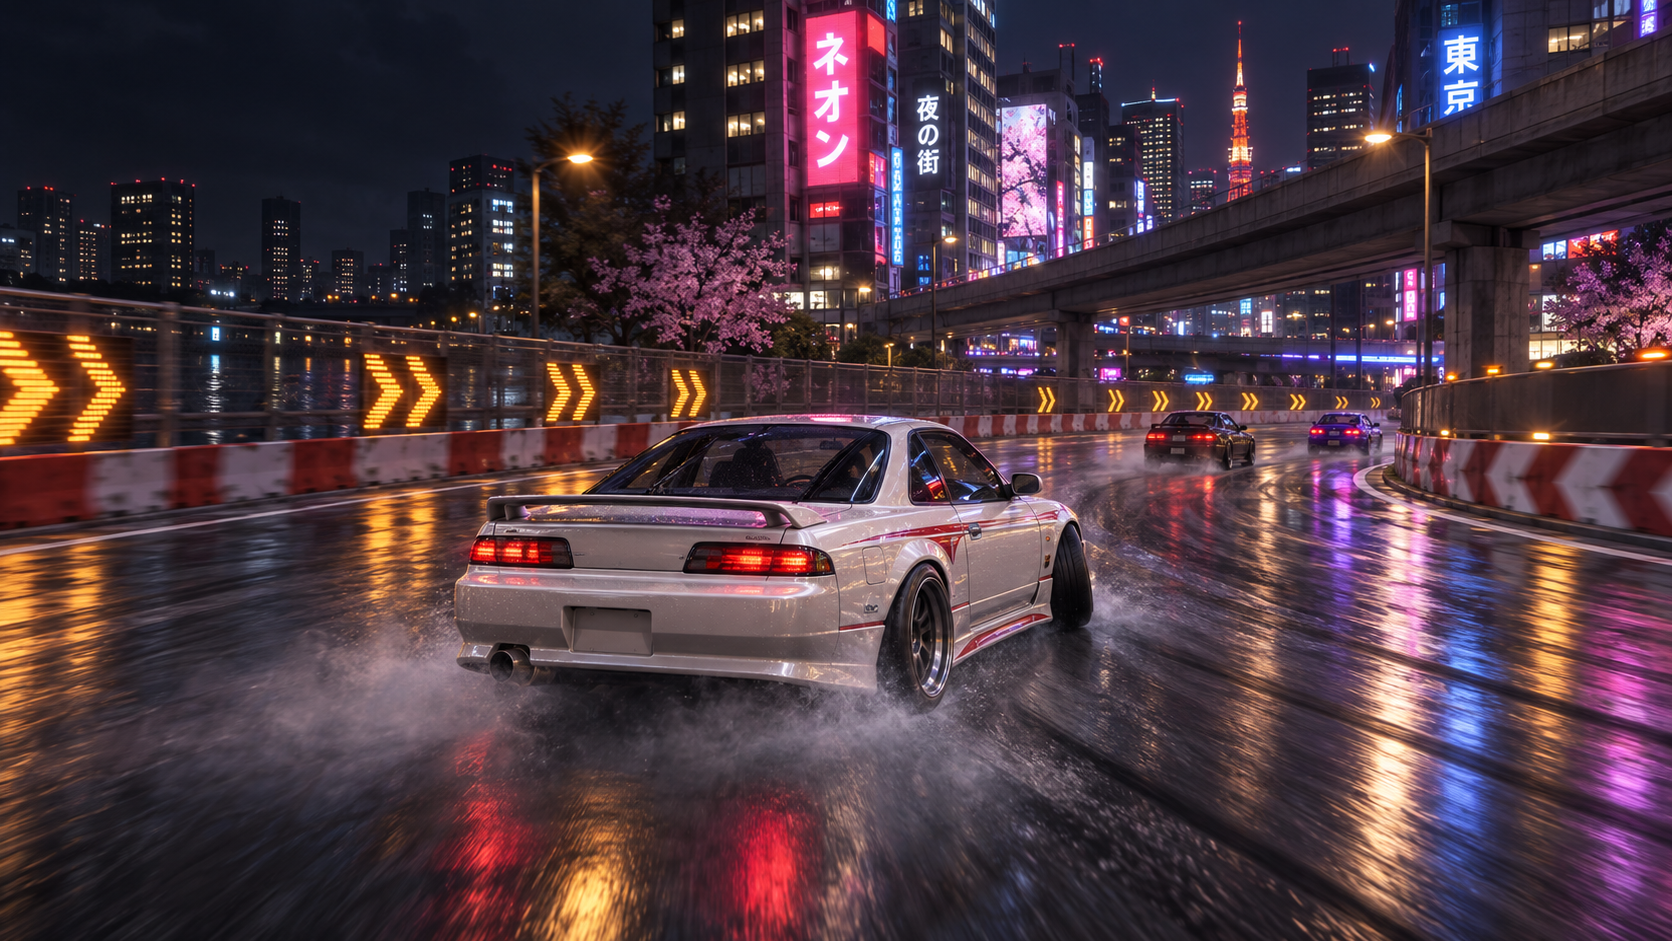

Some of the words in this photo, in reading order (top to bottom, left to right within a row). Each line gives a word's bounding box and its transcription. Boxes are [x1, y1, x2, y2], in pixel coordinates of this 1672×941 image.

[813, 32, 849, 168] ネオン
[1443, 34, 1479, 115] 東京
[916, 94, 940, 175] 夜の街
